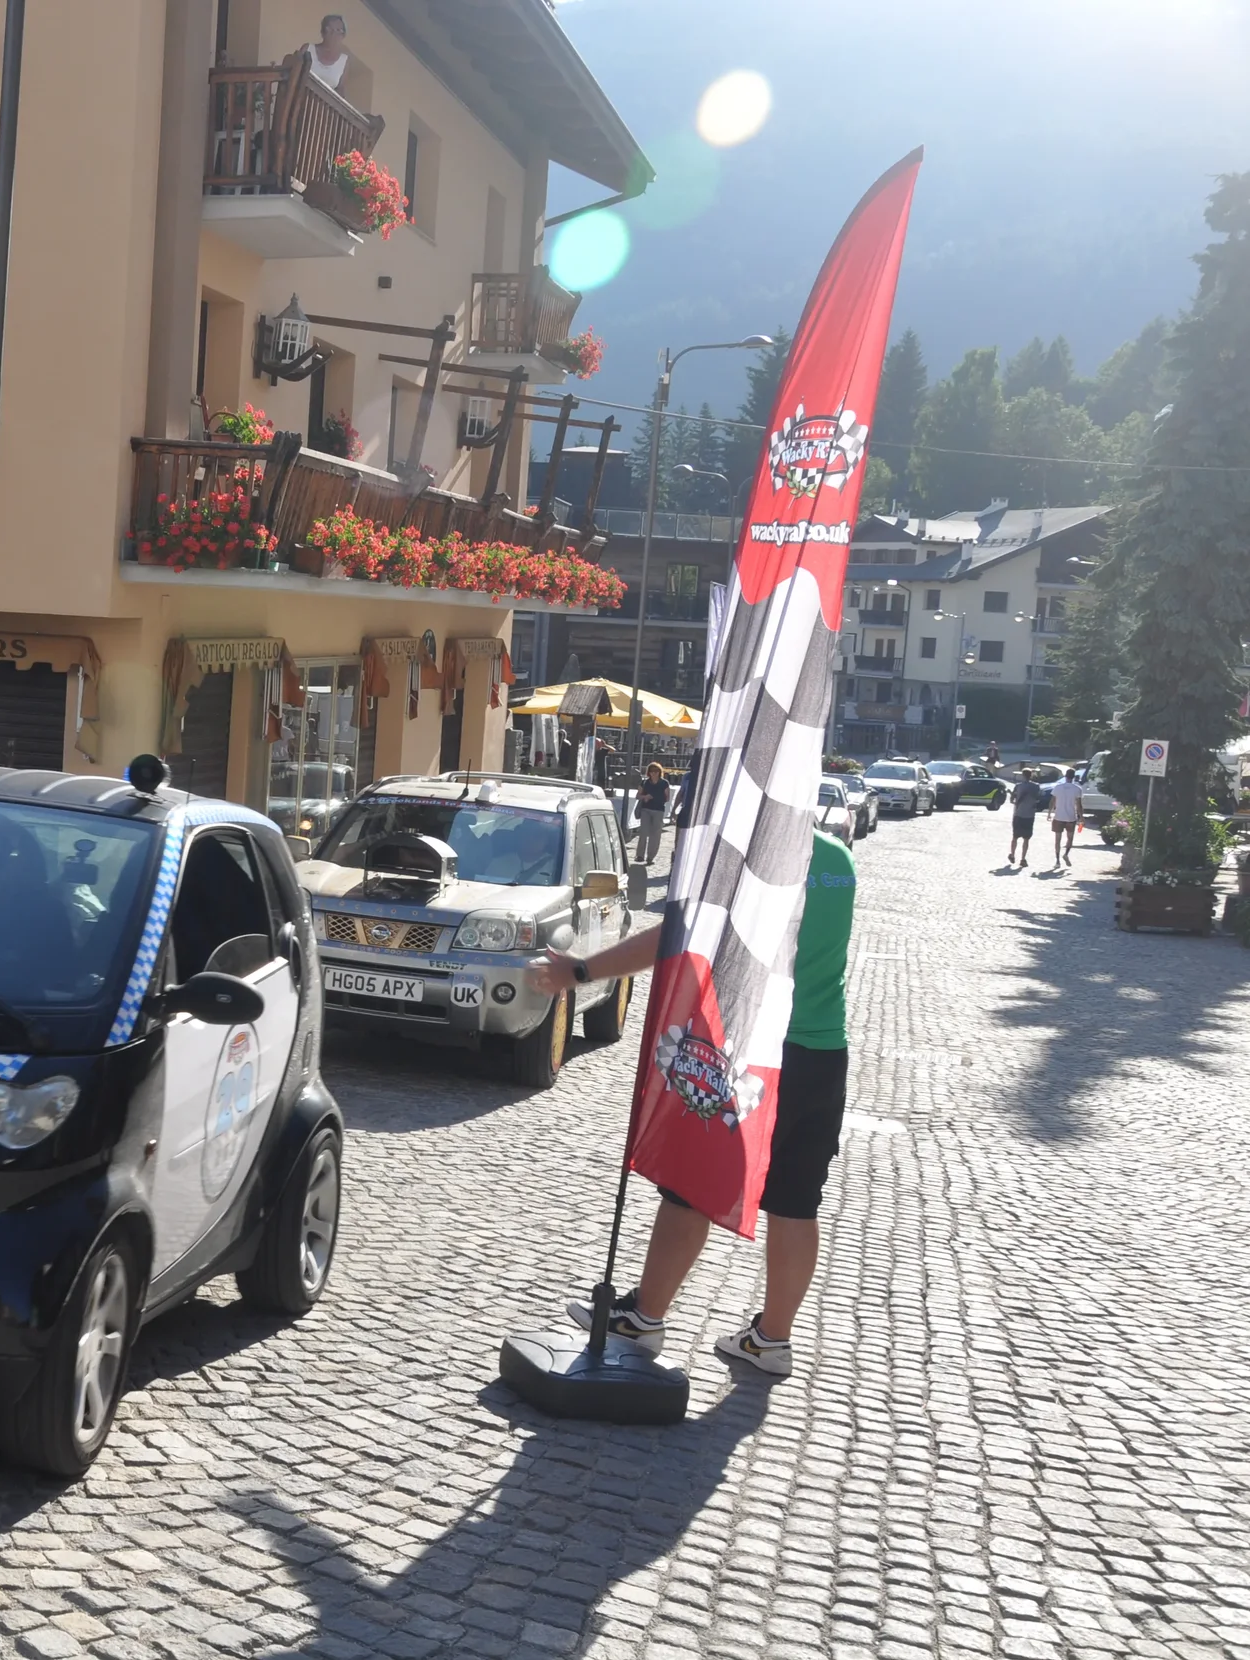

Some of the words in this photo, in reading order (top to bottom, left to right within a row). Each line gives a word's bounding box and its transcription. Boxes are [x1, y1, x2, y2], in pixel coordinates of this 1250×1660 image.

[782, 441, 815, 466] Wacky
[196, 643, 240, 662] ARTICOLI
[242, 641, 279, 661] REGALO
[429, 960, 468, 970] FENDT
[332, 972, 377, 993] HG05
[381, 979, 416, 998] APX
[453, 987, 479, 1004] UK
[705, 1070, 733, 1102] Rally
